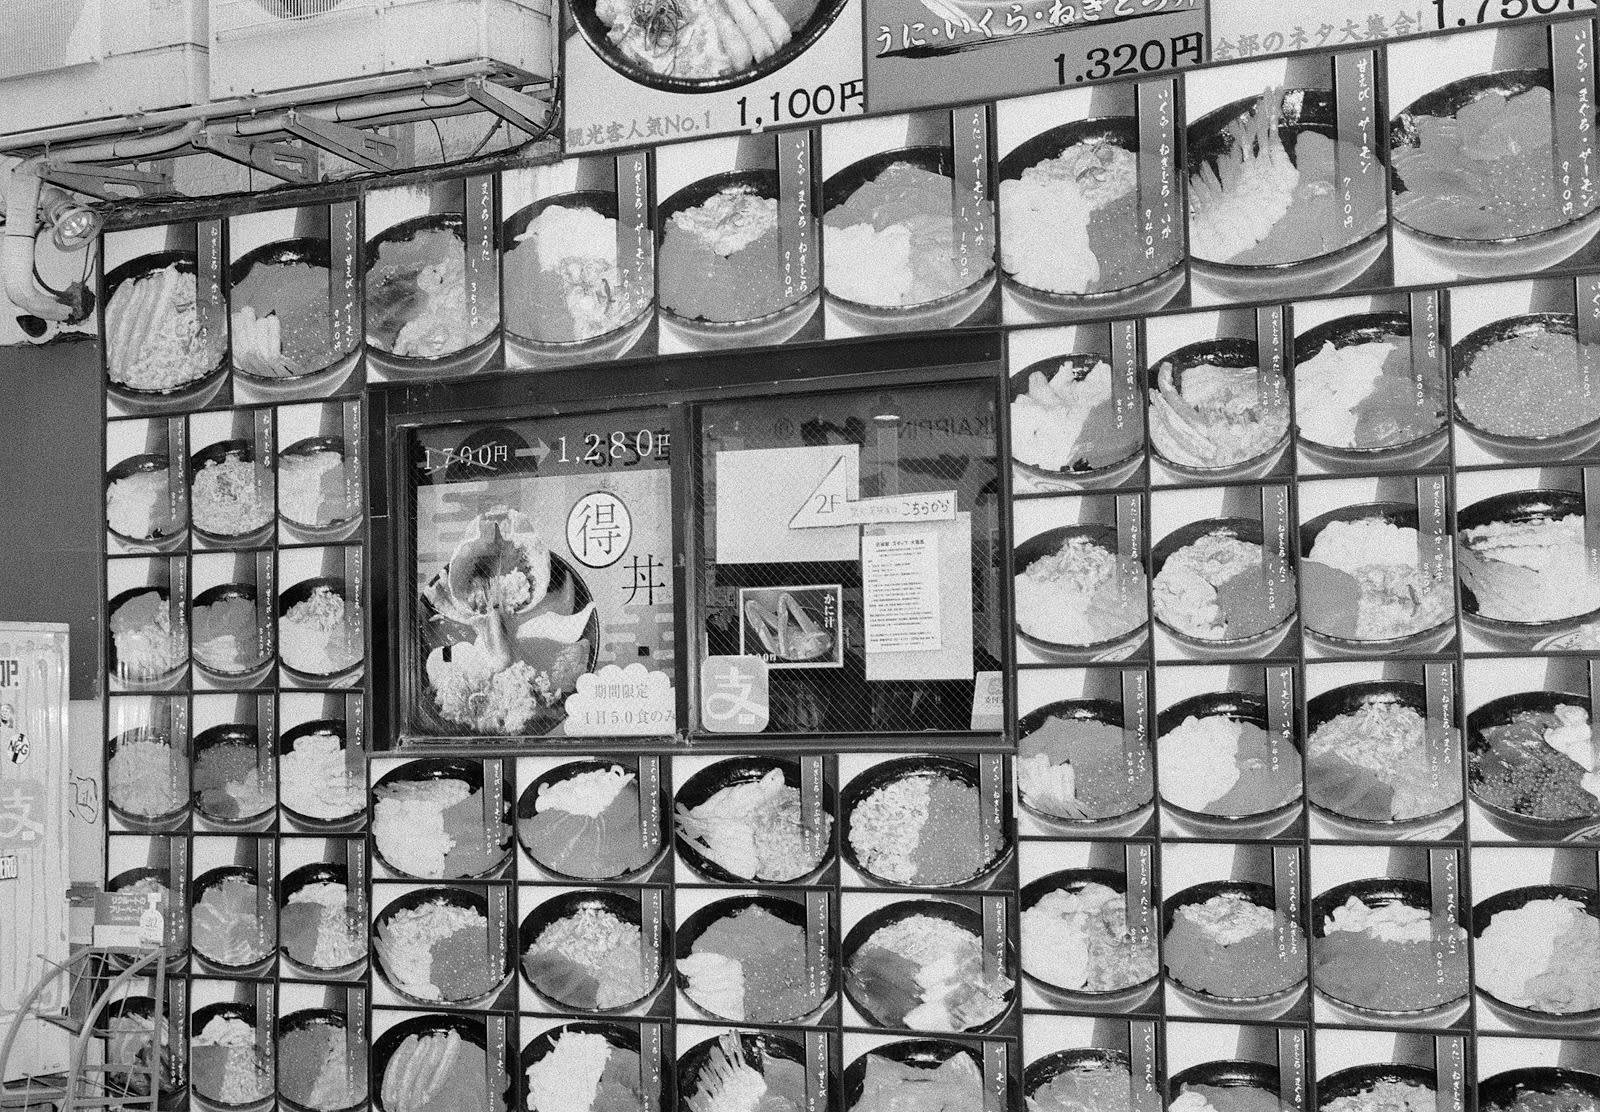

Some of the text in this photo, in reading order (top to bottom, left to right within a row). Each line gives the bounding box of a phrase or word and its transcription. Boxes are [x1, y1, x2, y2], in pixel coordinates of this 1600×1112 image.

[1358, 58, 1373, 173] 甘えび・サーモン
[1574, 30, 1594, 207] いくら・まぐろ・サーモン
[1344, 177, 1353, 227] 760円
[1562, 161, 1573, 215] 990円
[961, 207, 969, 277] 1,150円
[1145, 209, 1155, 258] 940円
[577, 503, 622, 557] 得
[814, 494, 841, 514] 2F
[621, 554, 666, 606] 丼
[823, 593, 835, 629] かに汁
[595, 684, 649, 699] 期間限定
